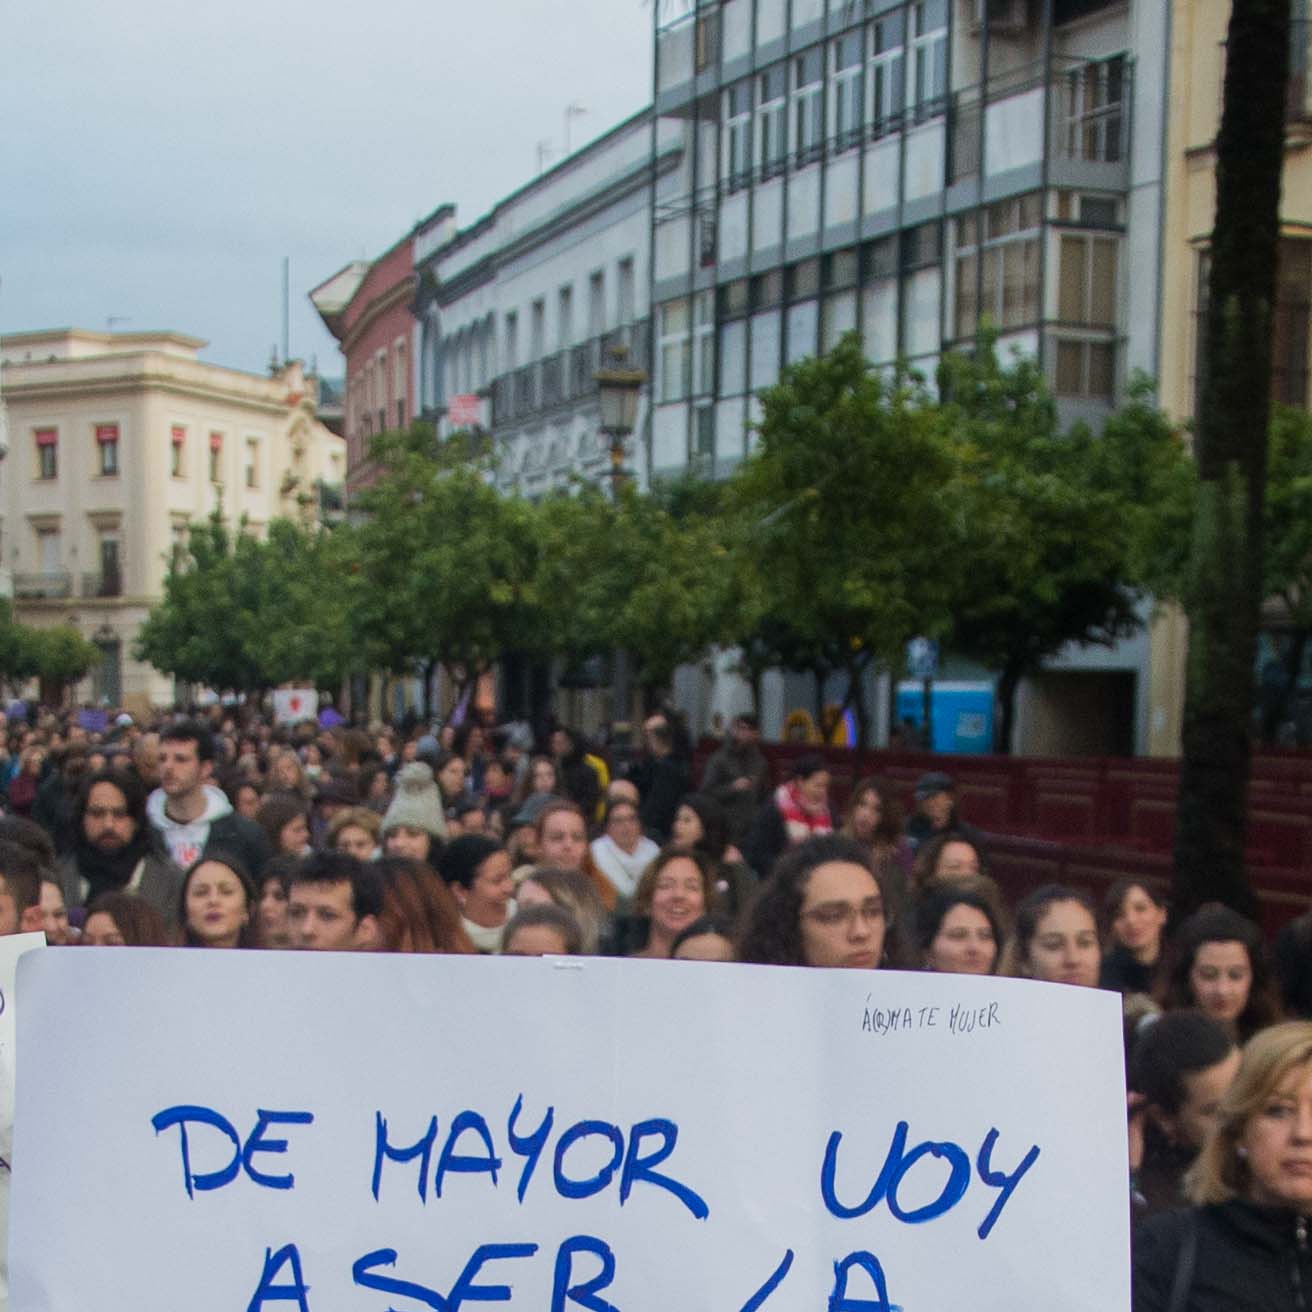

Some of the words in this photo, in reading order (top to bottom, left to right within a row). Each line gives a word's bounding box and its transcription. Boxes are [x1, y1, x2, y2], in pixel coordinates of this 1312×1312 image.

[949, 1001, 1001, 1034] MUJER
[151, 1105, 315, 1195] DE
[371, 1096, 709, 1221] MAYOR
